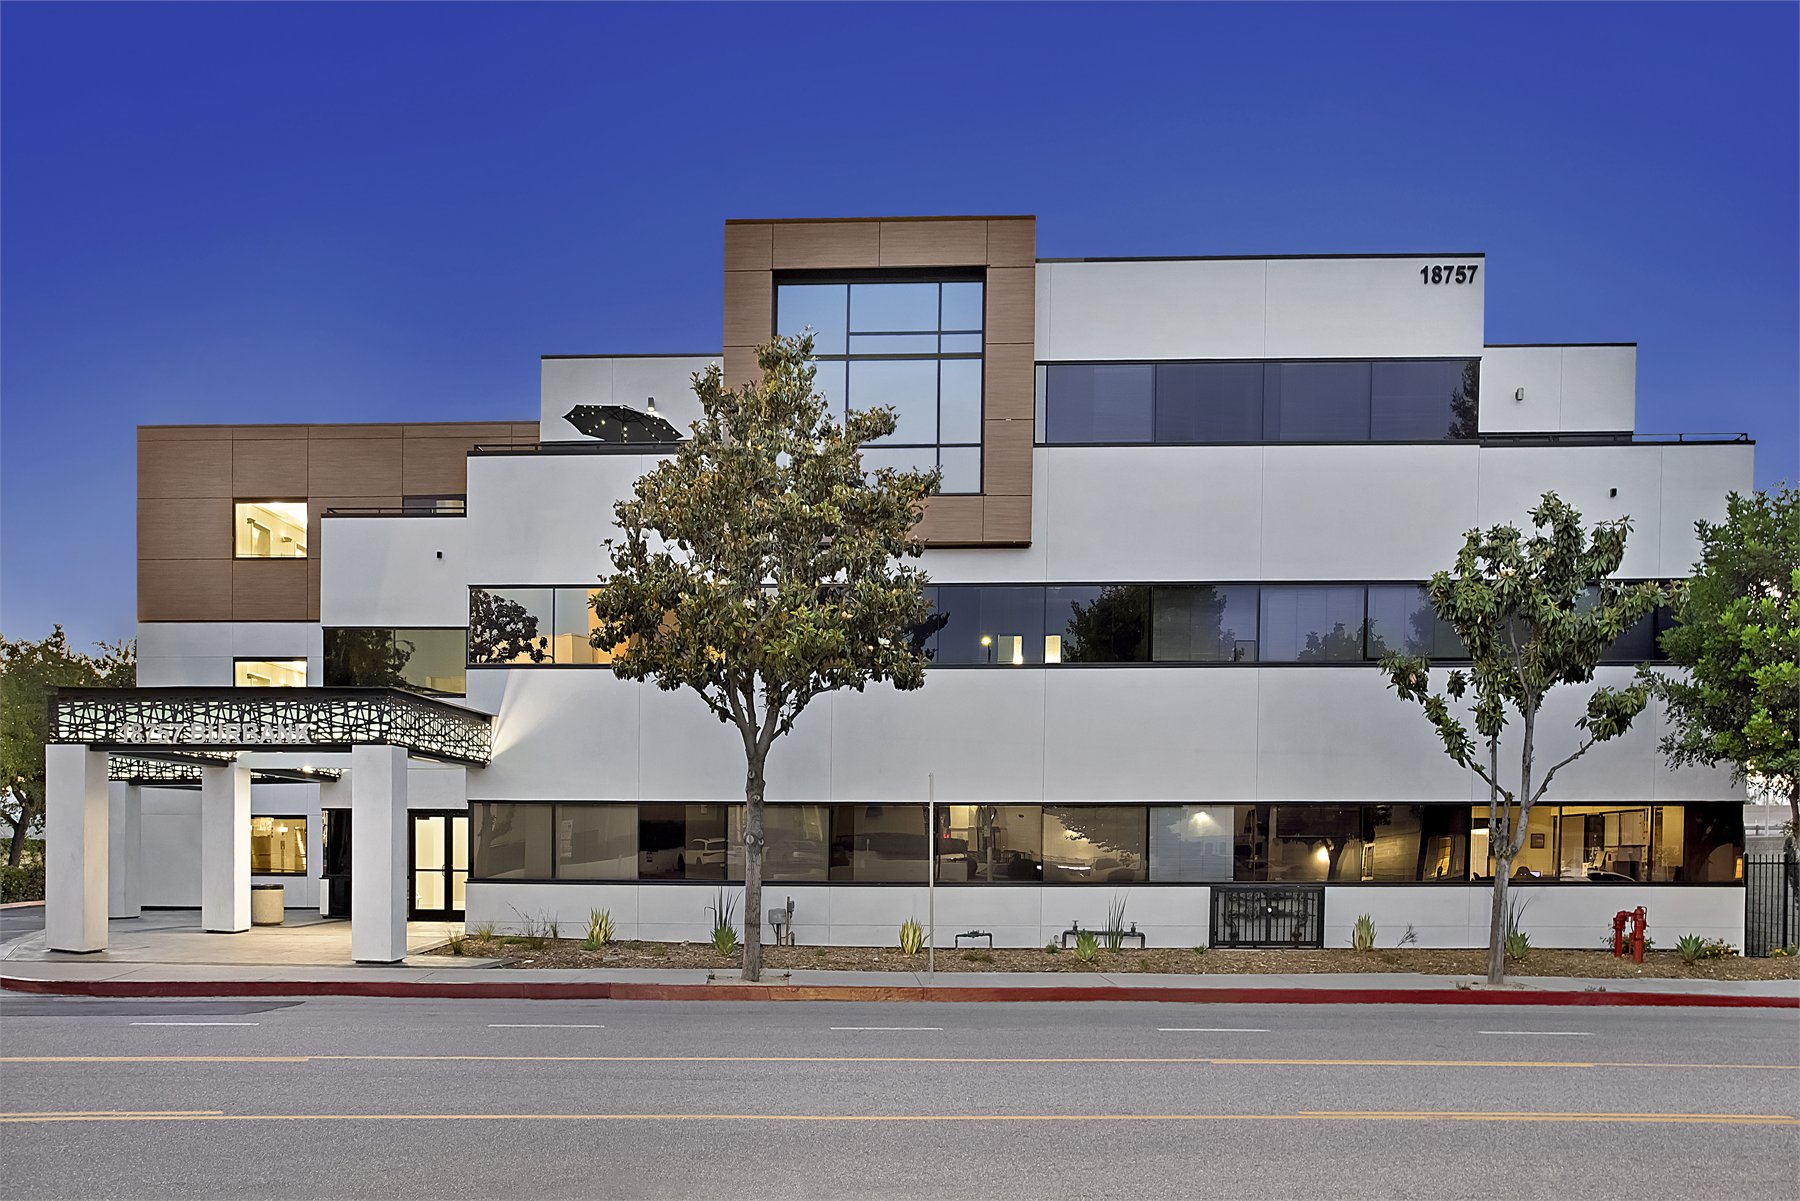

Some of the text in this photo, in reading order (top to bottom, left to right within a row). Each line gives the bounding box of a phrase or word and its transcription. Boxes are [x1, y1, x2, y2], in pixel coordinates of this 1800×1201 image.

[1420, 265, 1479, 285] 18757
[118, 723, 313, 744] 18757 BURBANK
